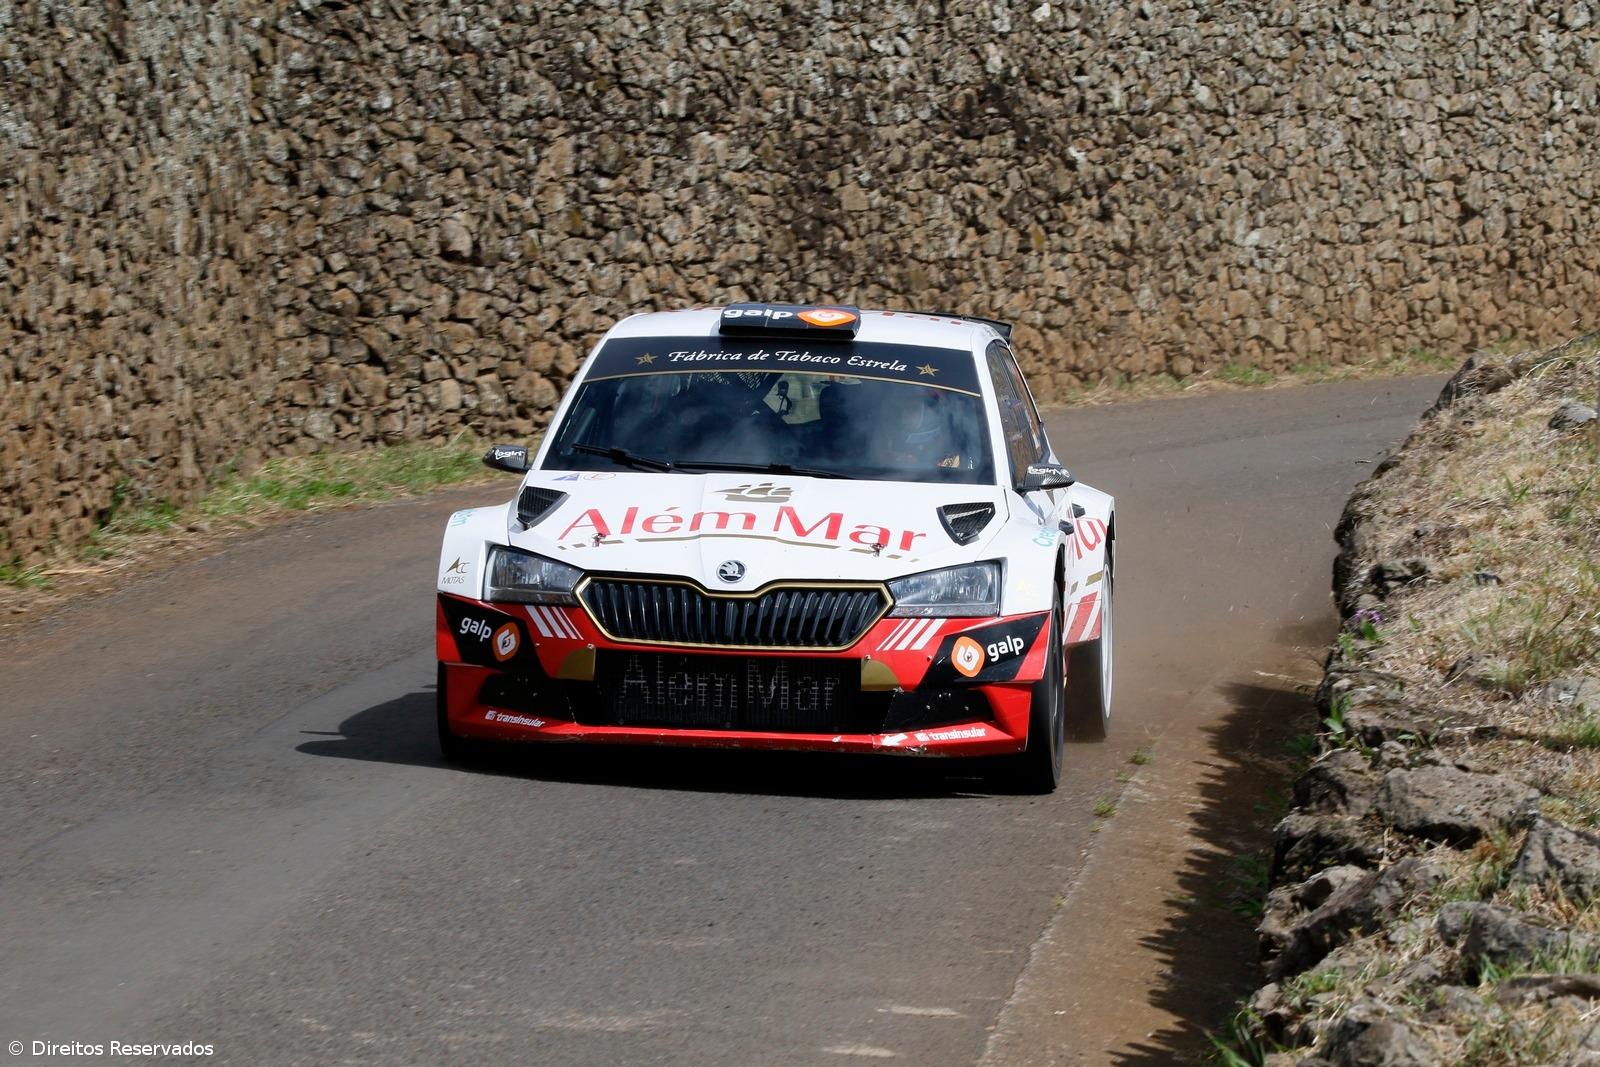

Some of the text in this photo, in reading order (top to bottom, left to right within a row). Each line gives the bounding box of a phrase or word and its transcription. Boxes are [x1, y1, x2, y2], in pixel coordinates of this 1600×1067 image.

[723, 308, 794, 320] galp
[668, 350, 908, 372] Fábrica de Tabaco Estrela
[557, 505, 927, 552] Além Mar
[459, 617, 493, 642] galp
[987, 634, 1025, 663] galp
[496, 711, 547, 728] transinsular
[930, 726, 987, 741] transinsular
